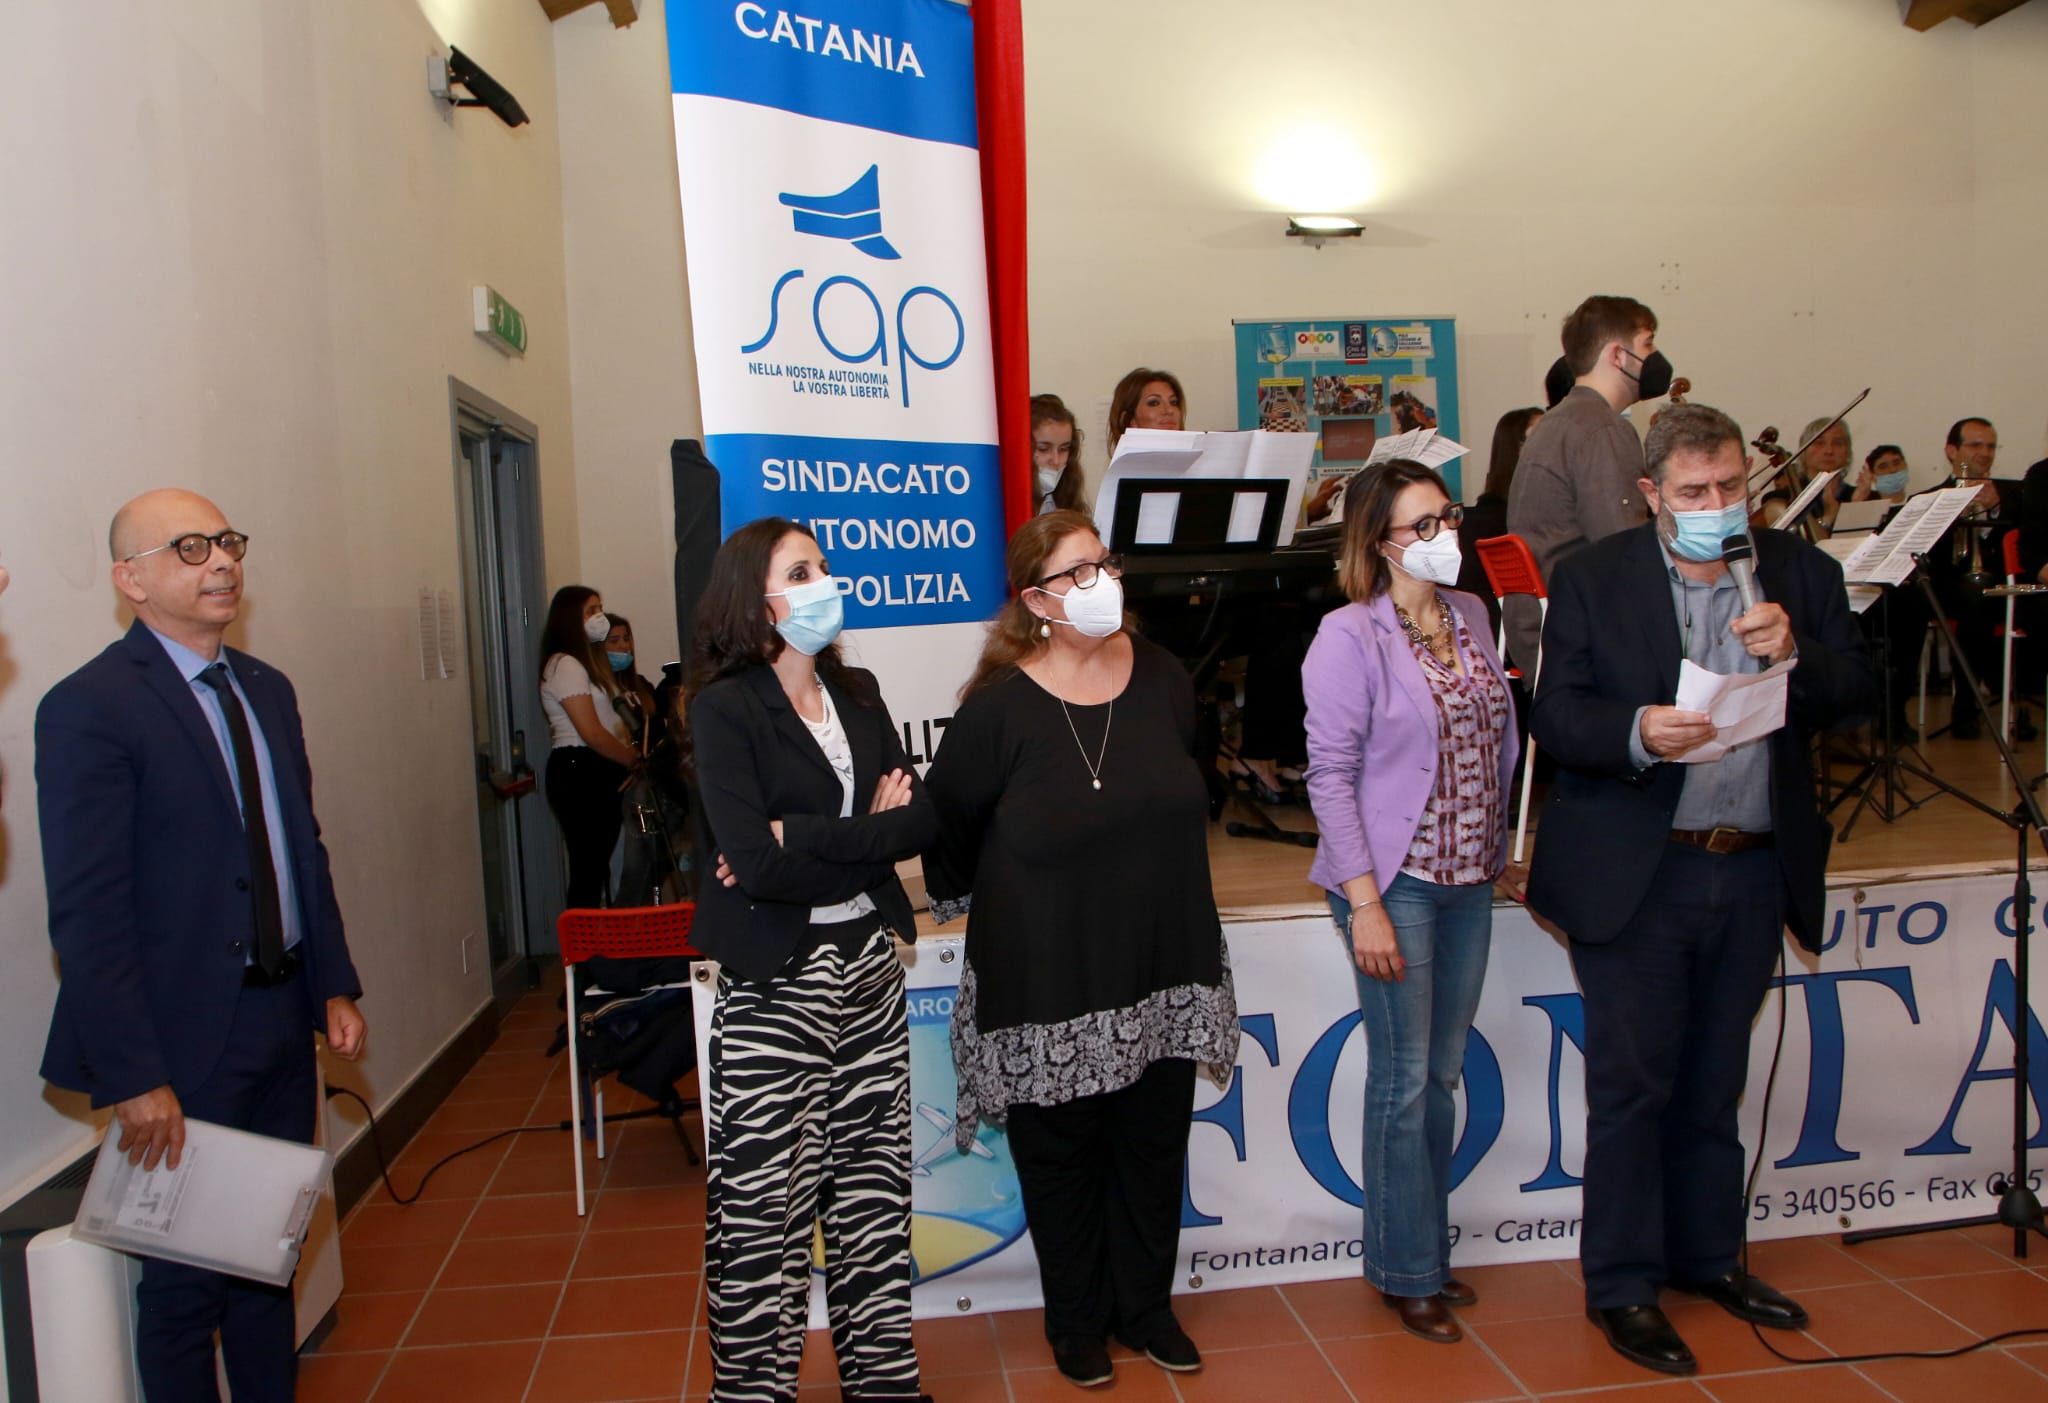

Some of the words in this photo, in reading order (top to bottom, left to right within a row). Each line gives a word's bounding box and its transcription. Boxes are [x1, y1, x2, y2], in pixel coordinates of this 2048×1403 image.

[734, 1, 926, 79] CATANIA
[741, 269, 965, 408] sap
[748, 361, 783, 377] NELLA
[786, 365, 825, 381] NOSTRA
[828, 369, 889, 386] AUTONOMIA
[792, 380, 805, 393] LA
[808, 381, 847, 397] VOSTRA
[850, 385, 890, 399] LIBERTÀ
[761, 458, 971, 496] SINDACATO
[791, 517, 976, 550] TONOMO
[906, 996, 954, 1017] ARO
[1190, 1239, 1365, 1273] Fontanaro
[1782, 1179, 1896, 1219] 340566
[1927, 1177, 1977, 1203] Fax
